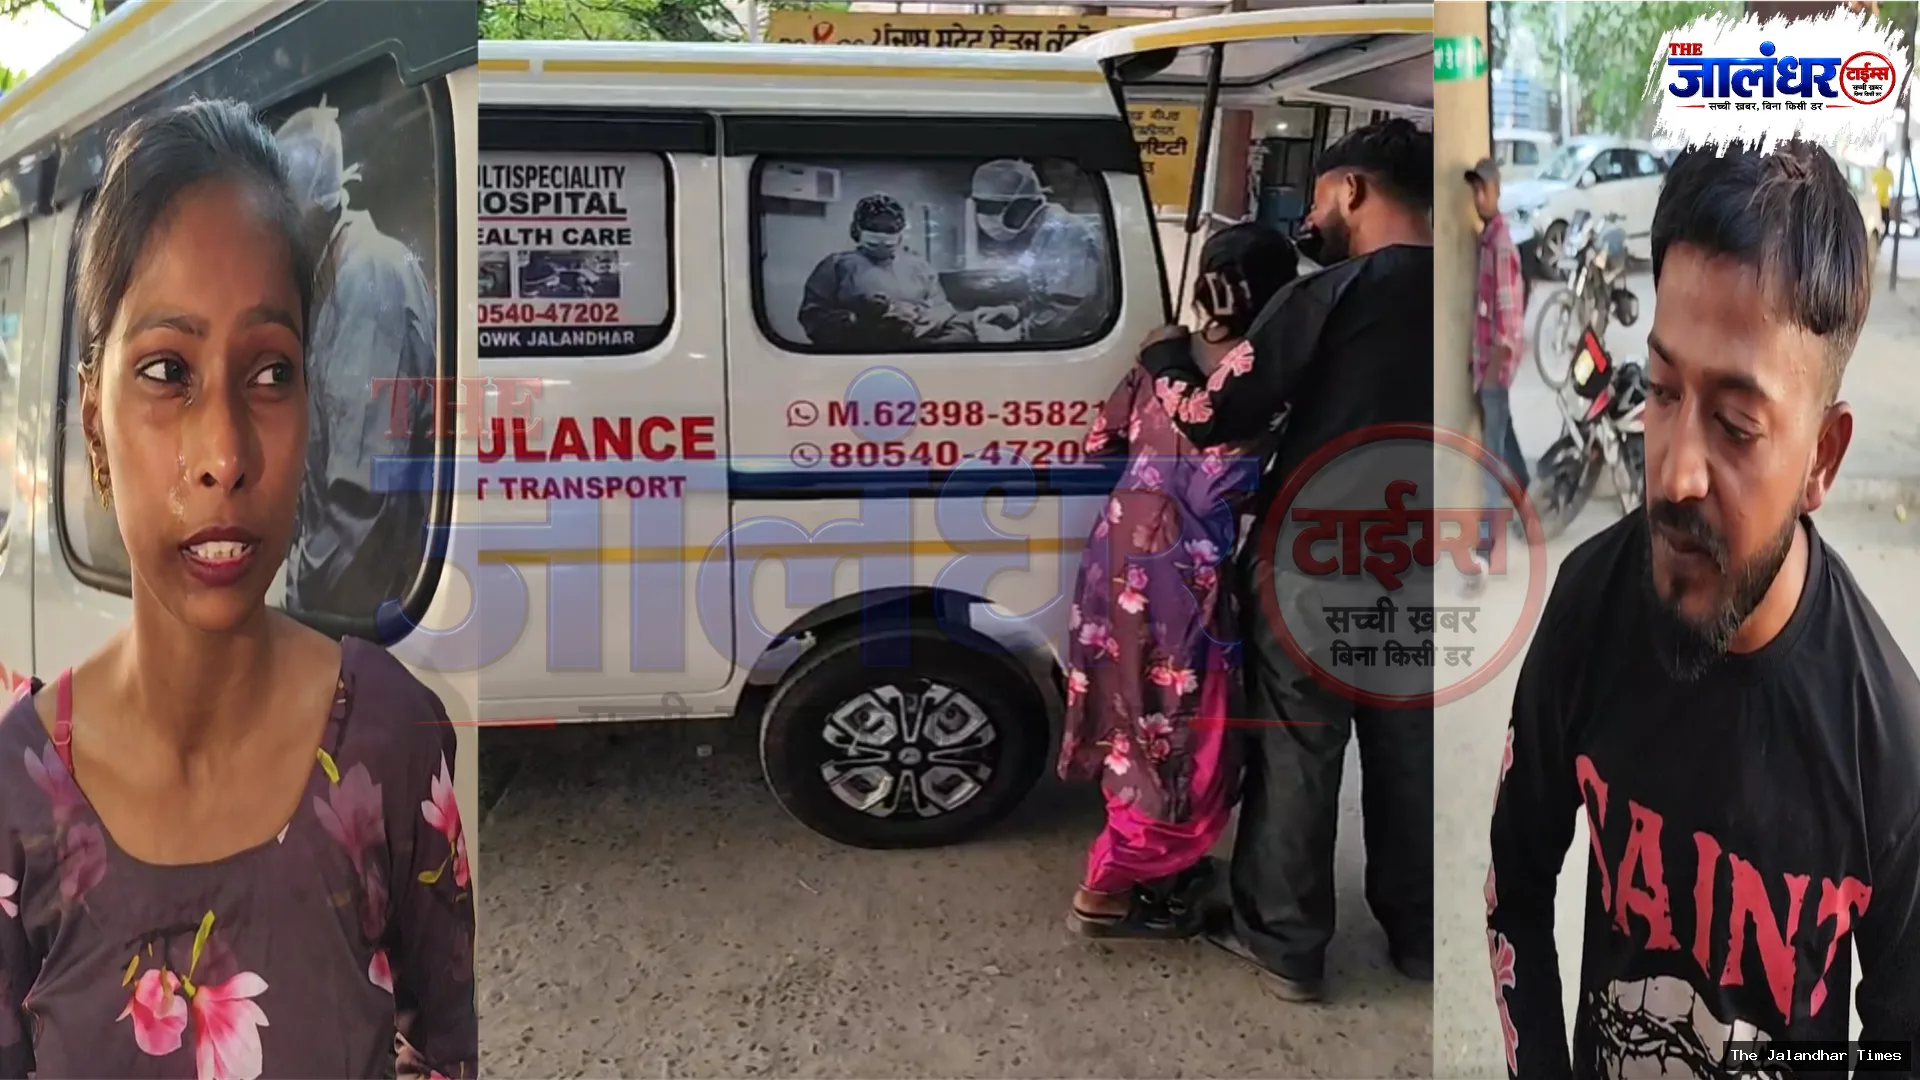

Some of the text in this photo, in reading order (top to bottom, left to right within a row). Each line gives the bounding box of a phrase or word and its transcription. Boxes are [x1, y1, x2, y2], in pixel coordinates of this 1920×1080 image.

[562, 228, 631, 246] CARE
[479, 331, 635, 347] OWK JALANDHAR
[498, 475, 686, 500] TRANSPORT
[1575, 754, 1873, 1026] SAINT
